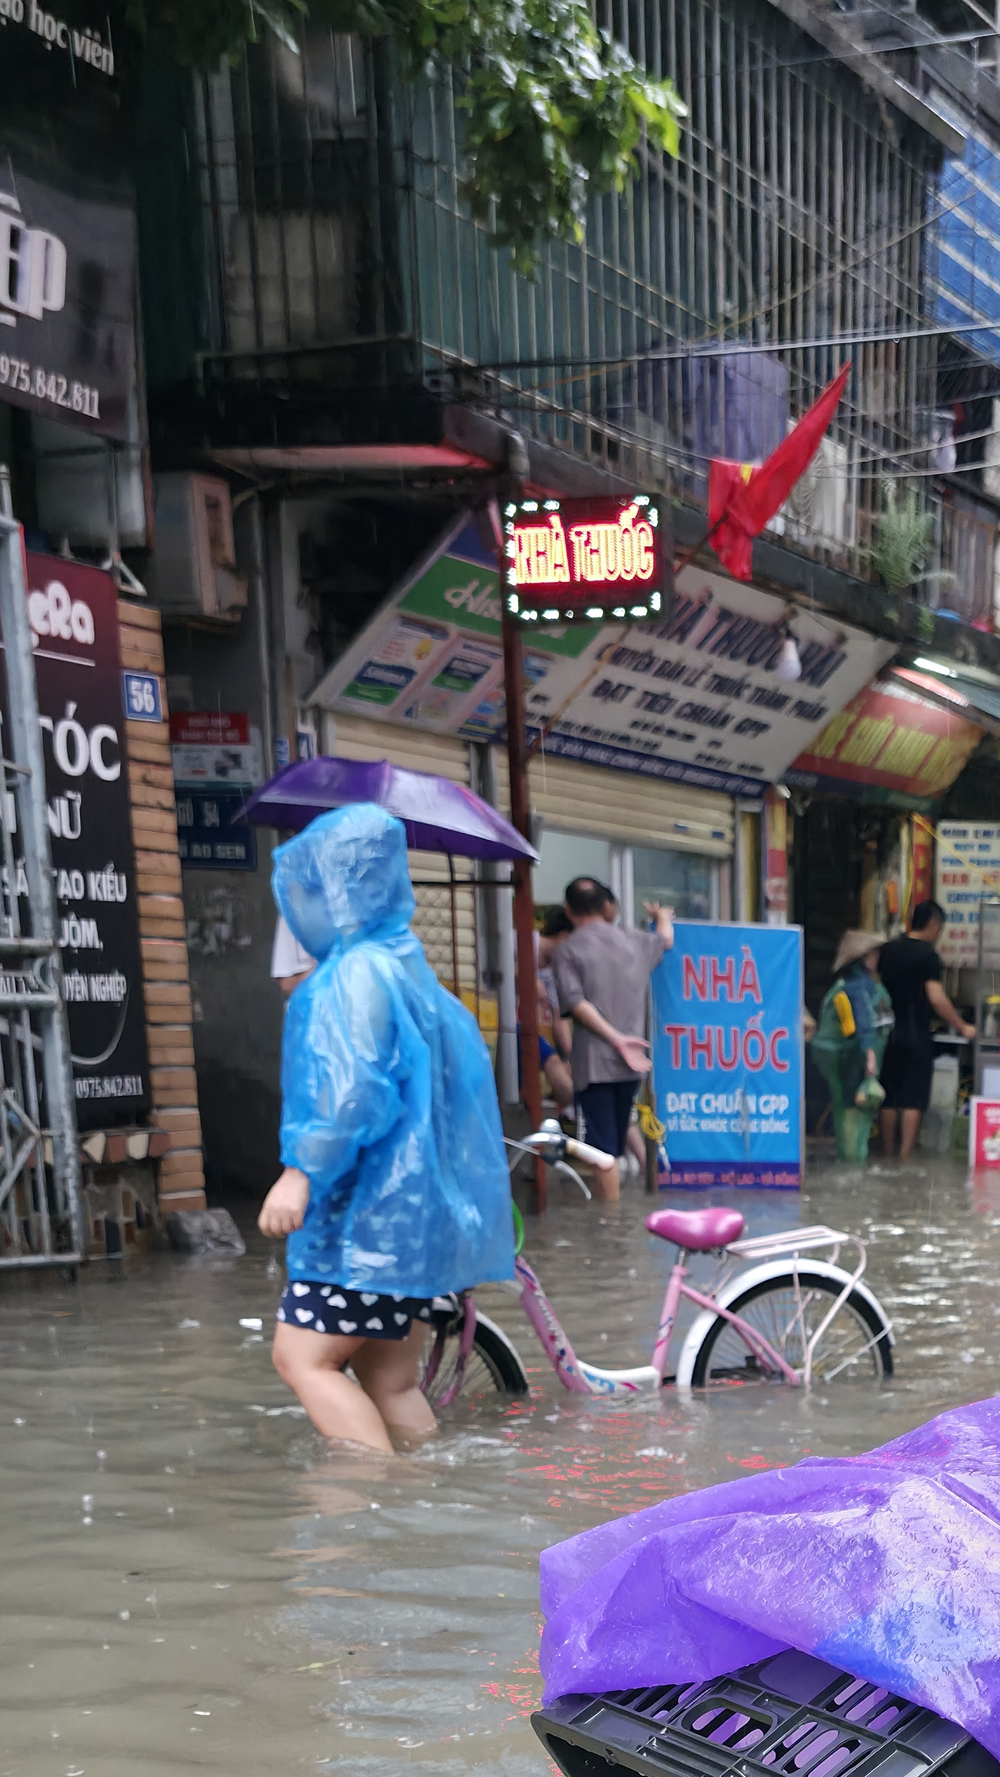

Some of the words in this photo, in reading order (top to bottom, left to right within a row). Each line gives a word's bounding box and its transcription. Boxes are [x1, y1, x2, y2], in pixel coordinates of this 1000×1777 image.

[30, 0, 68, 50] học
[52, 868, 85, 905] ẠO
[682, 944, 763, 1004] NHÀ
[664, 1010, 790, 1073] THUỐC
